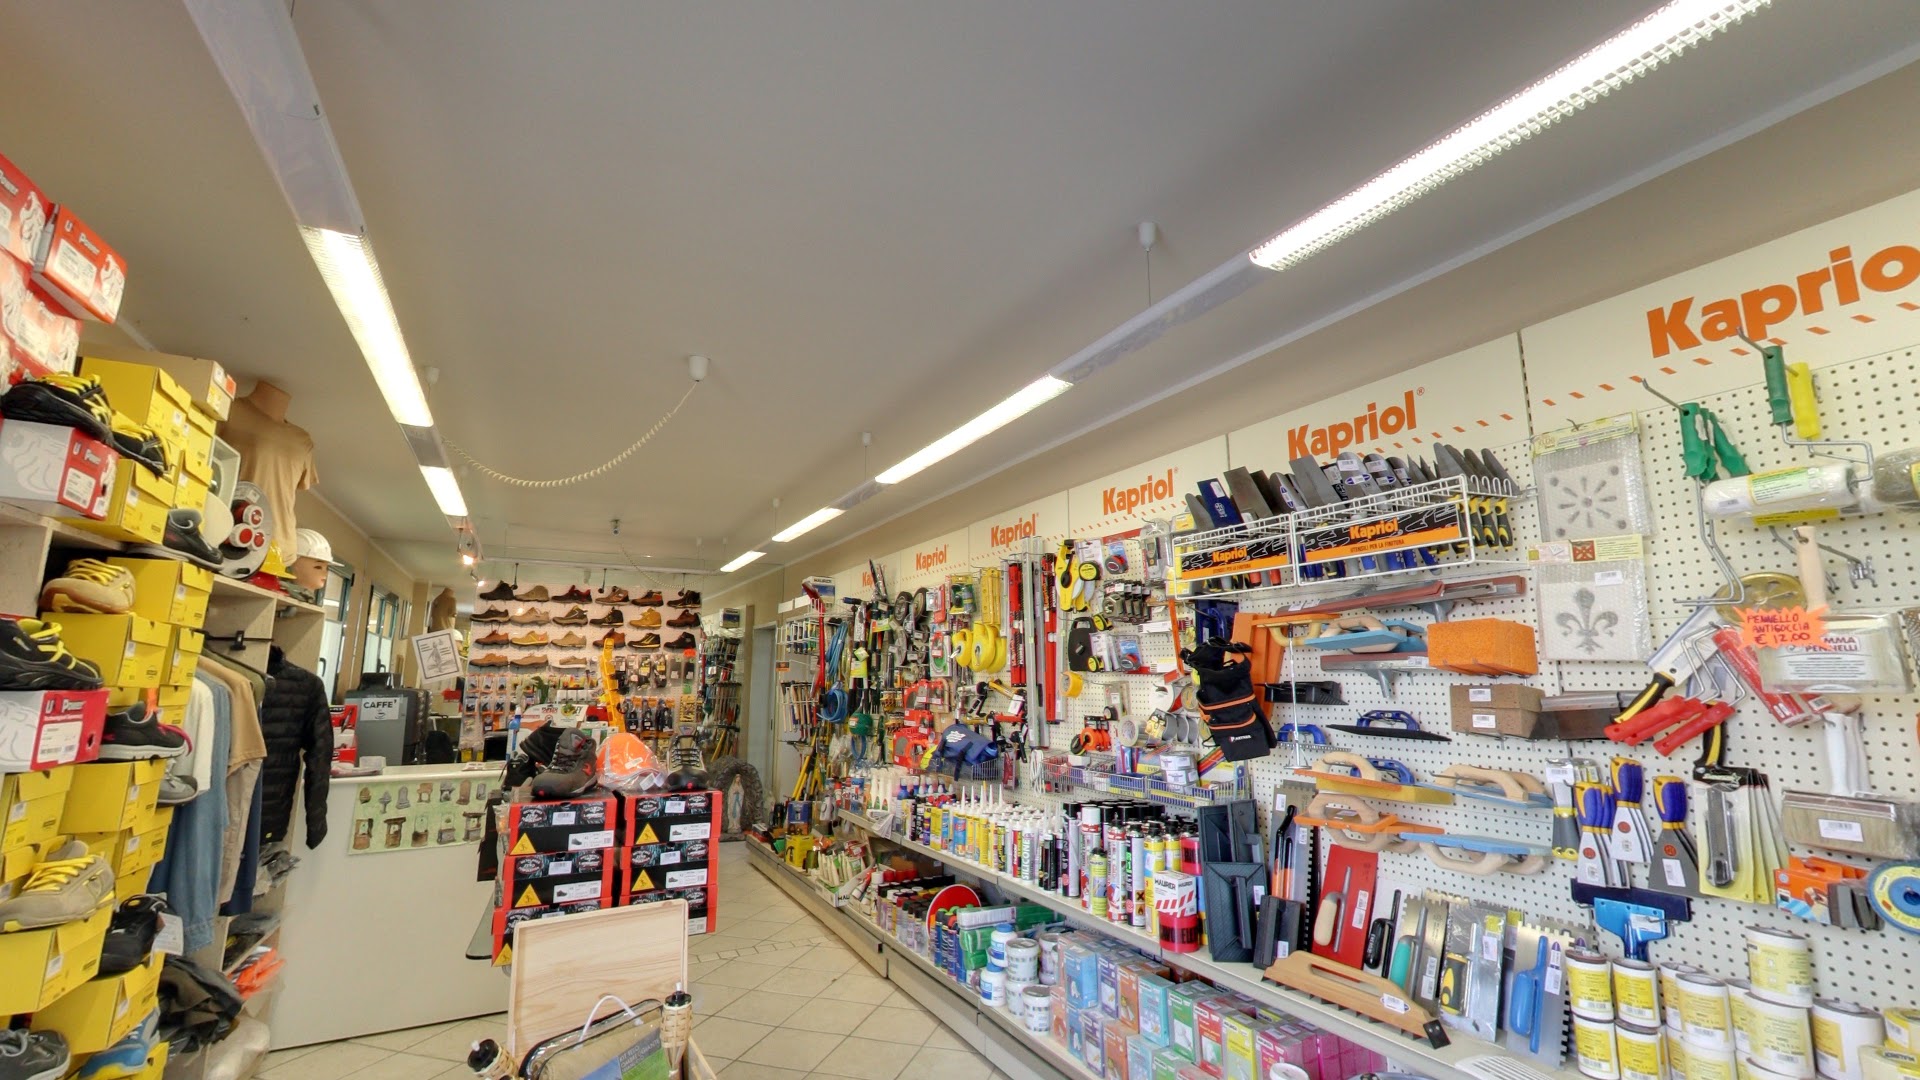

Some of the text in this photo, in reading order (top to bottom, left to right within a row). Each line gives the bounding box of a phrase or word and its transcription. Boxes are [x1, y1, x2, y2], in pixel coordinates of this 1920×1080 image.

[1287, 390, 1417, 461] Kapriol
[1103, 469, 1174, 516] Kapriol
[991, 513, 1036, 548] Kapriol
[1350, 517, 1399, 541] Kapriol
[916, 544, 947, 571] Kapriol
[1212, 544, 1247, 563] Kapriol
[1747, 613, 1799, 624] PENNELLO
[1754, 634, 1767, 645] €
[363, 699, 397, 709] CAFFE'
[1022, 839, 1031, 880] SILICONE
[1154, 878, 1177, 891] MAURER
